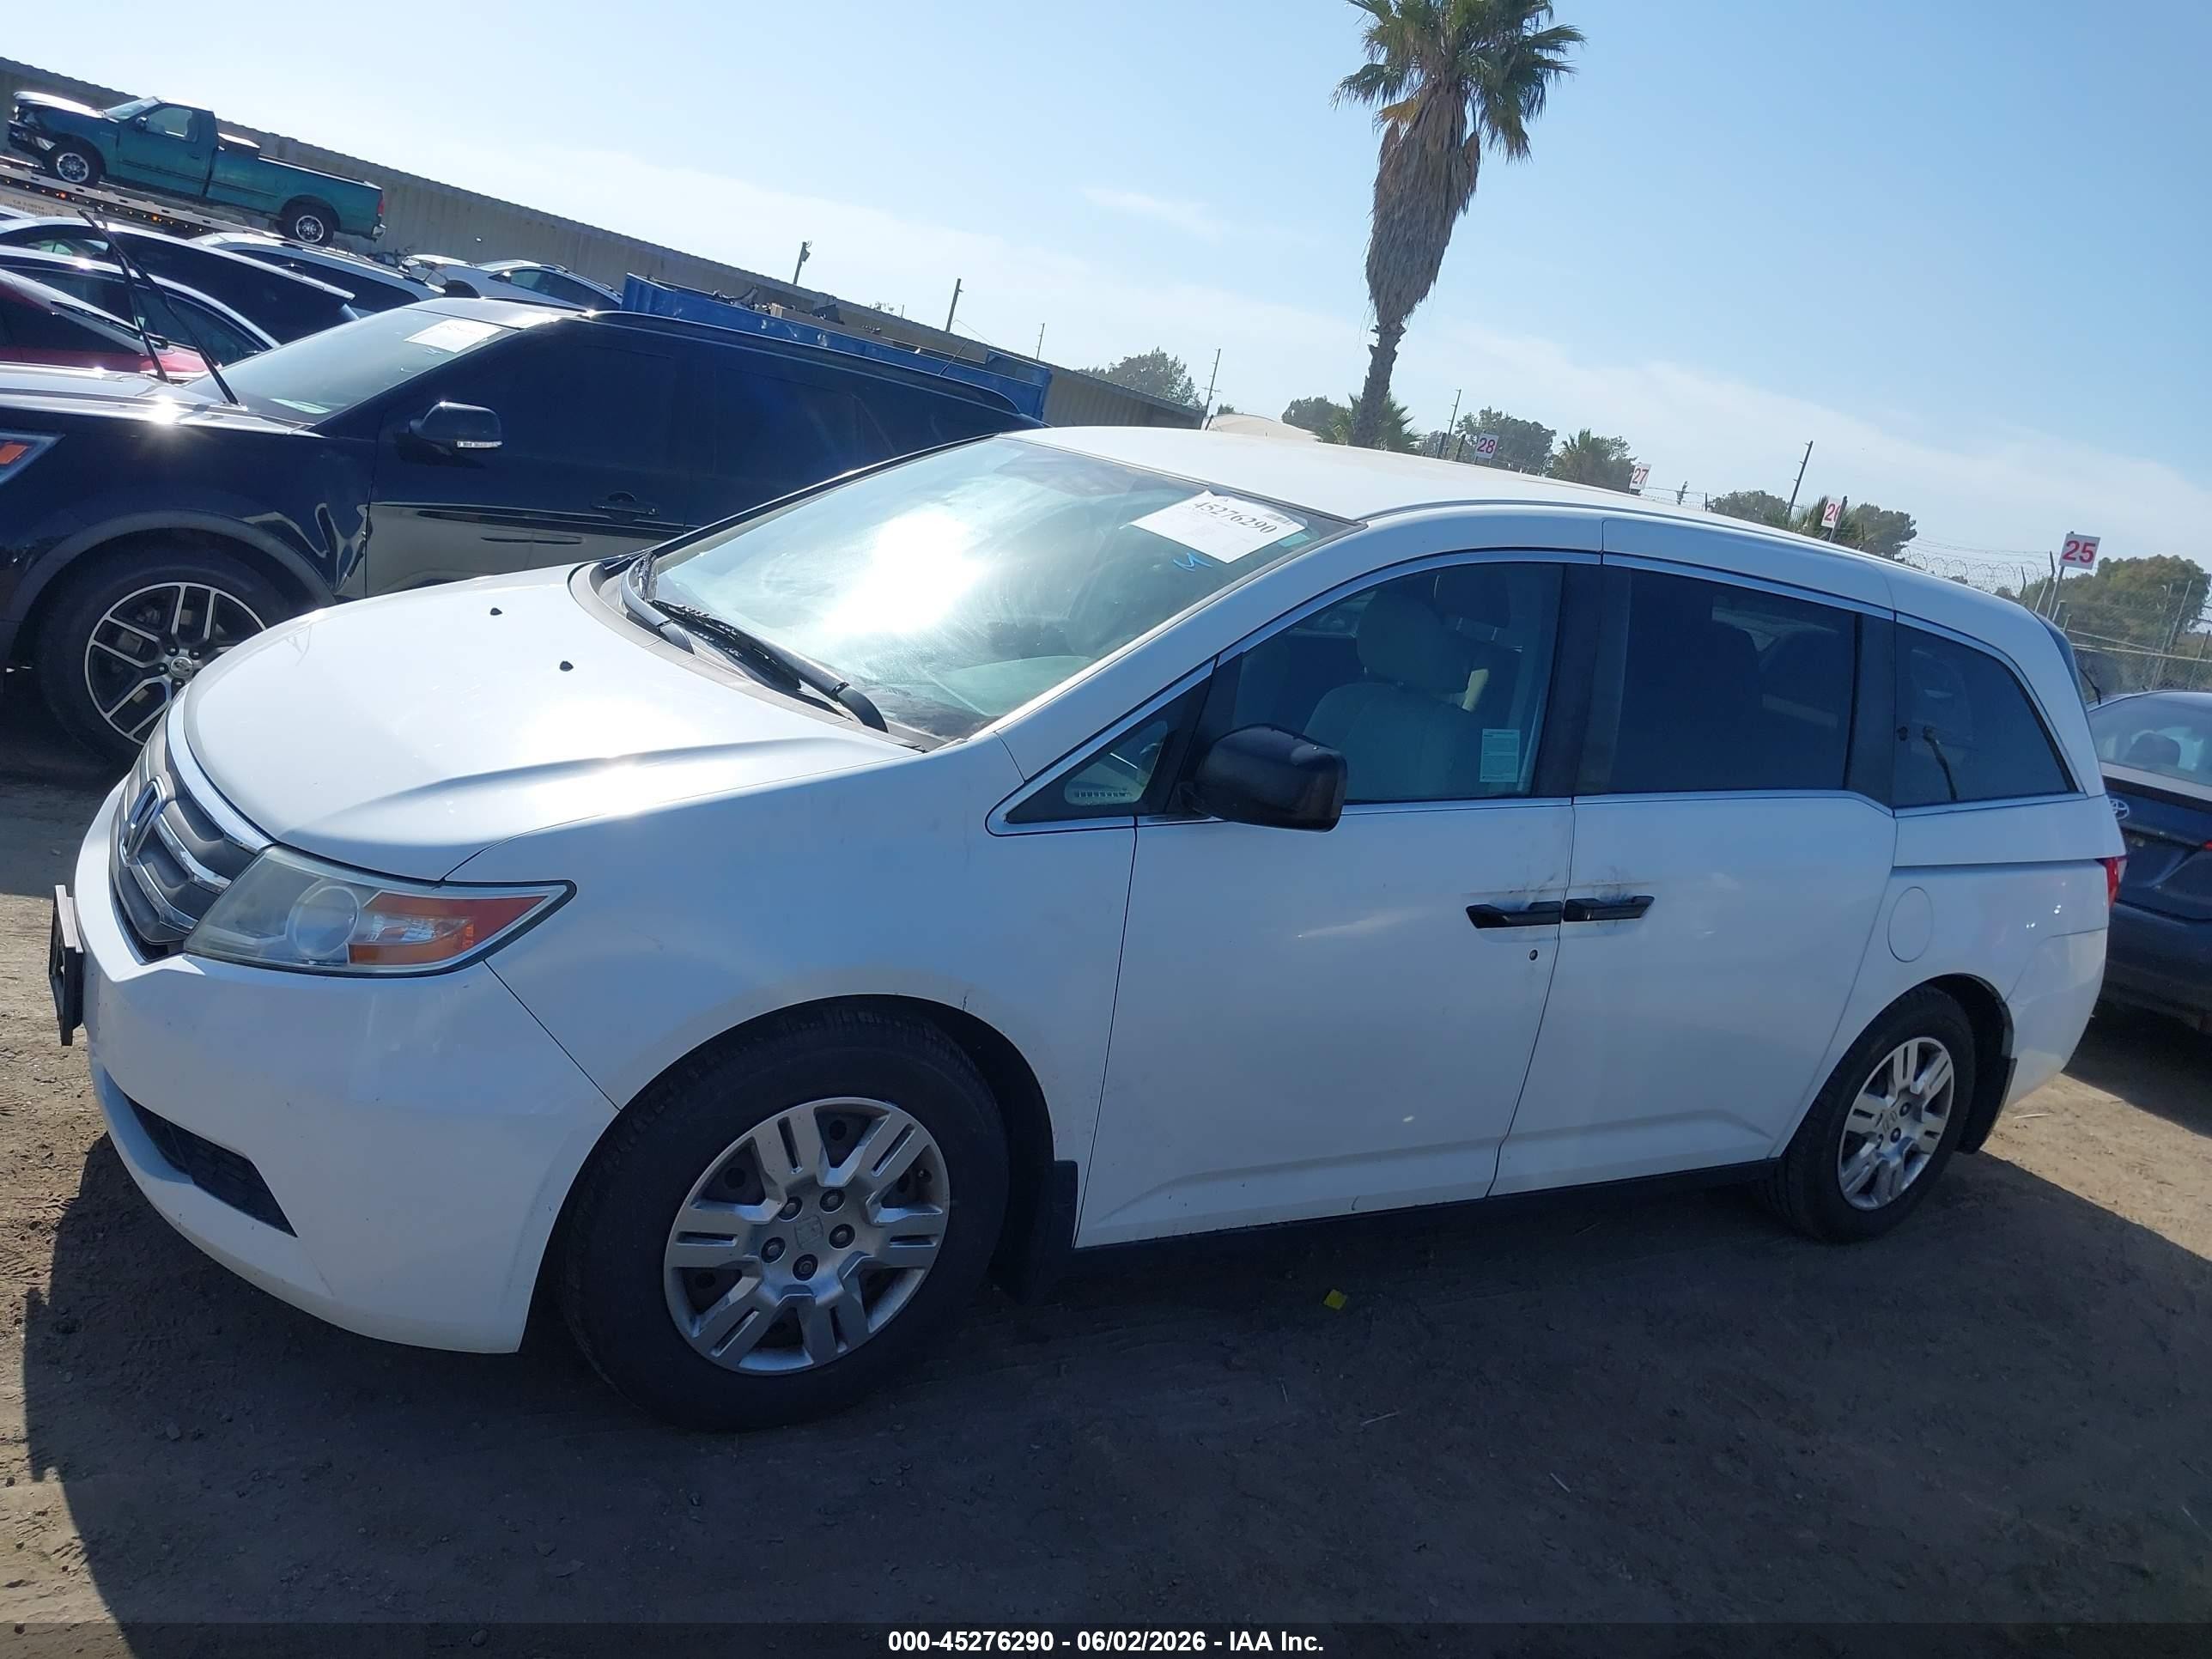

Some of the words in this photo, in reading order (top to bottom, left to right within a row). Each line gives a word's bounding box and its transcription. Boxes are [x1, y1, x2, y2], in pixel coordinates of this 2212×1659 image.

[1476, 436, 1496, 454] 28
[1632, 467, 1650, 485] 27
[1194, 501, 1278, 534] 45276290
[2062, 539, 2097, 563] 25
